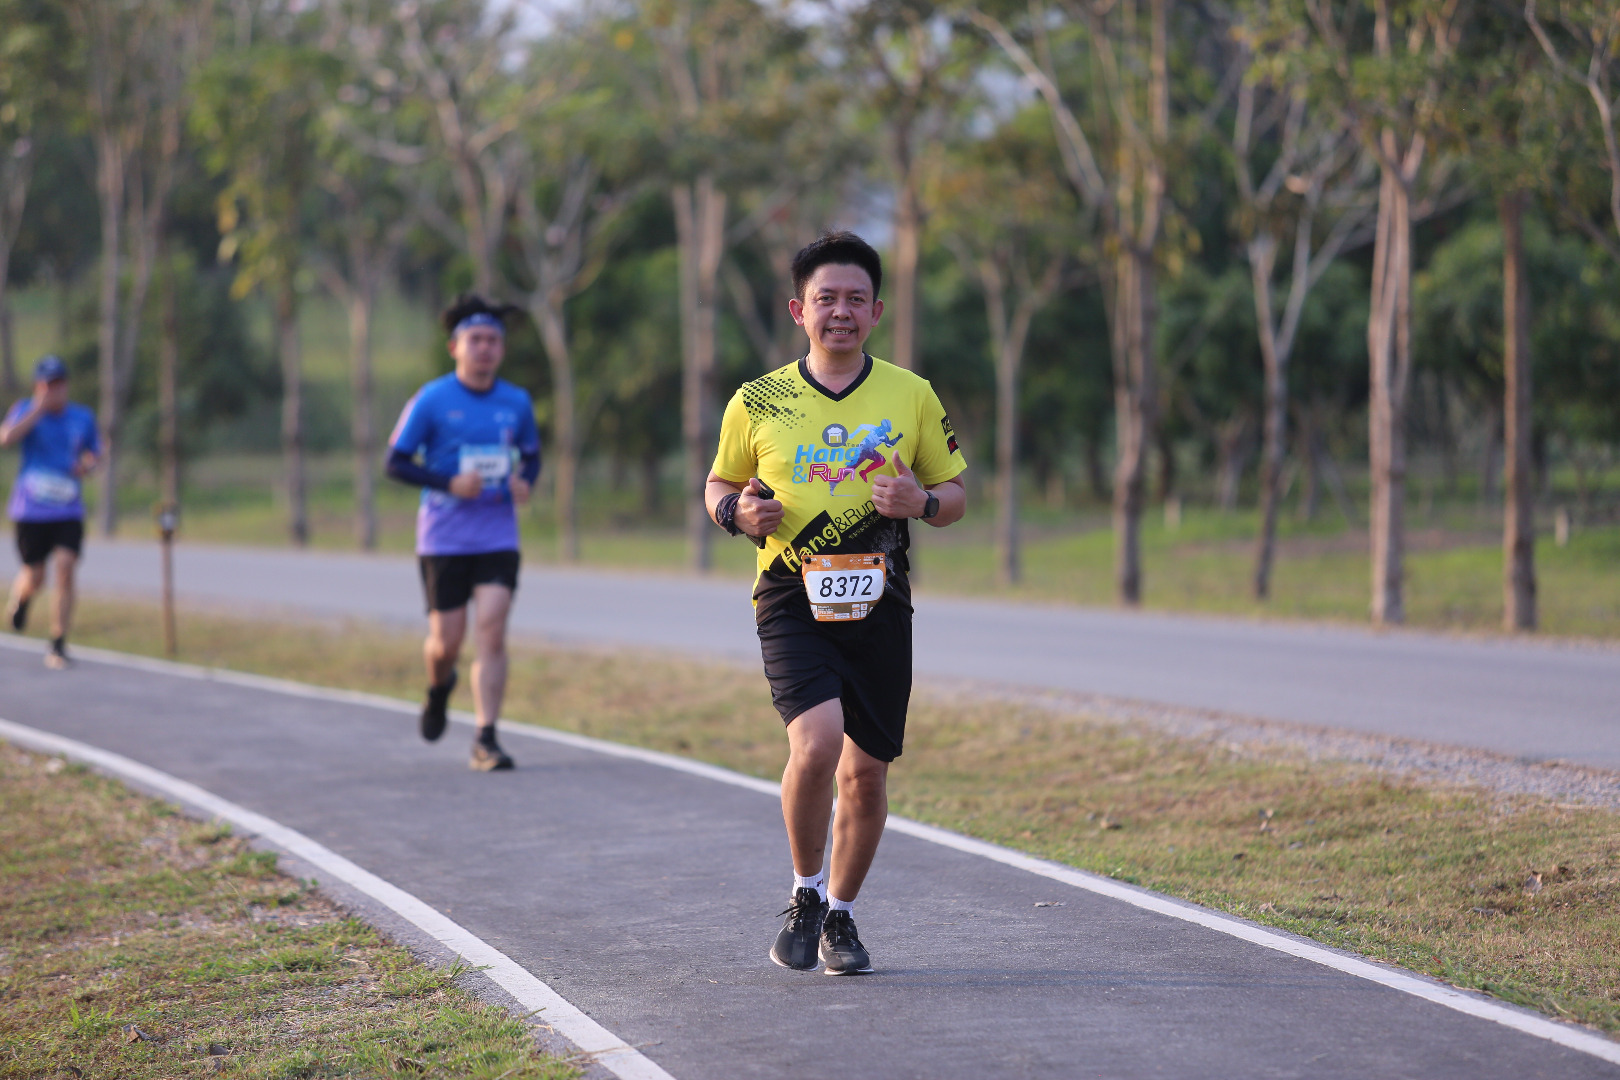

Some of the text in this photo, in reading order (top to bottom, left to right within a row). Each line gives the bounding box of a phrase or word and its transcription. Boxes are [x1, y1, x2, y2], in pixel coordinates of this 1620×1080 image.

[795, 444, 860, 466] Hang
[792, 464, 855, 484] &Run
[820, 576, 873, 598] 8372
